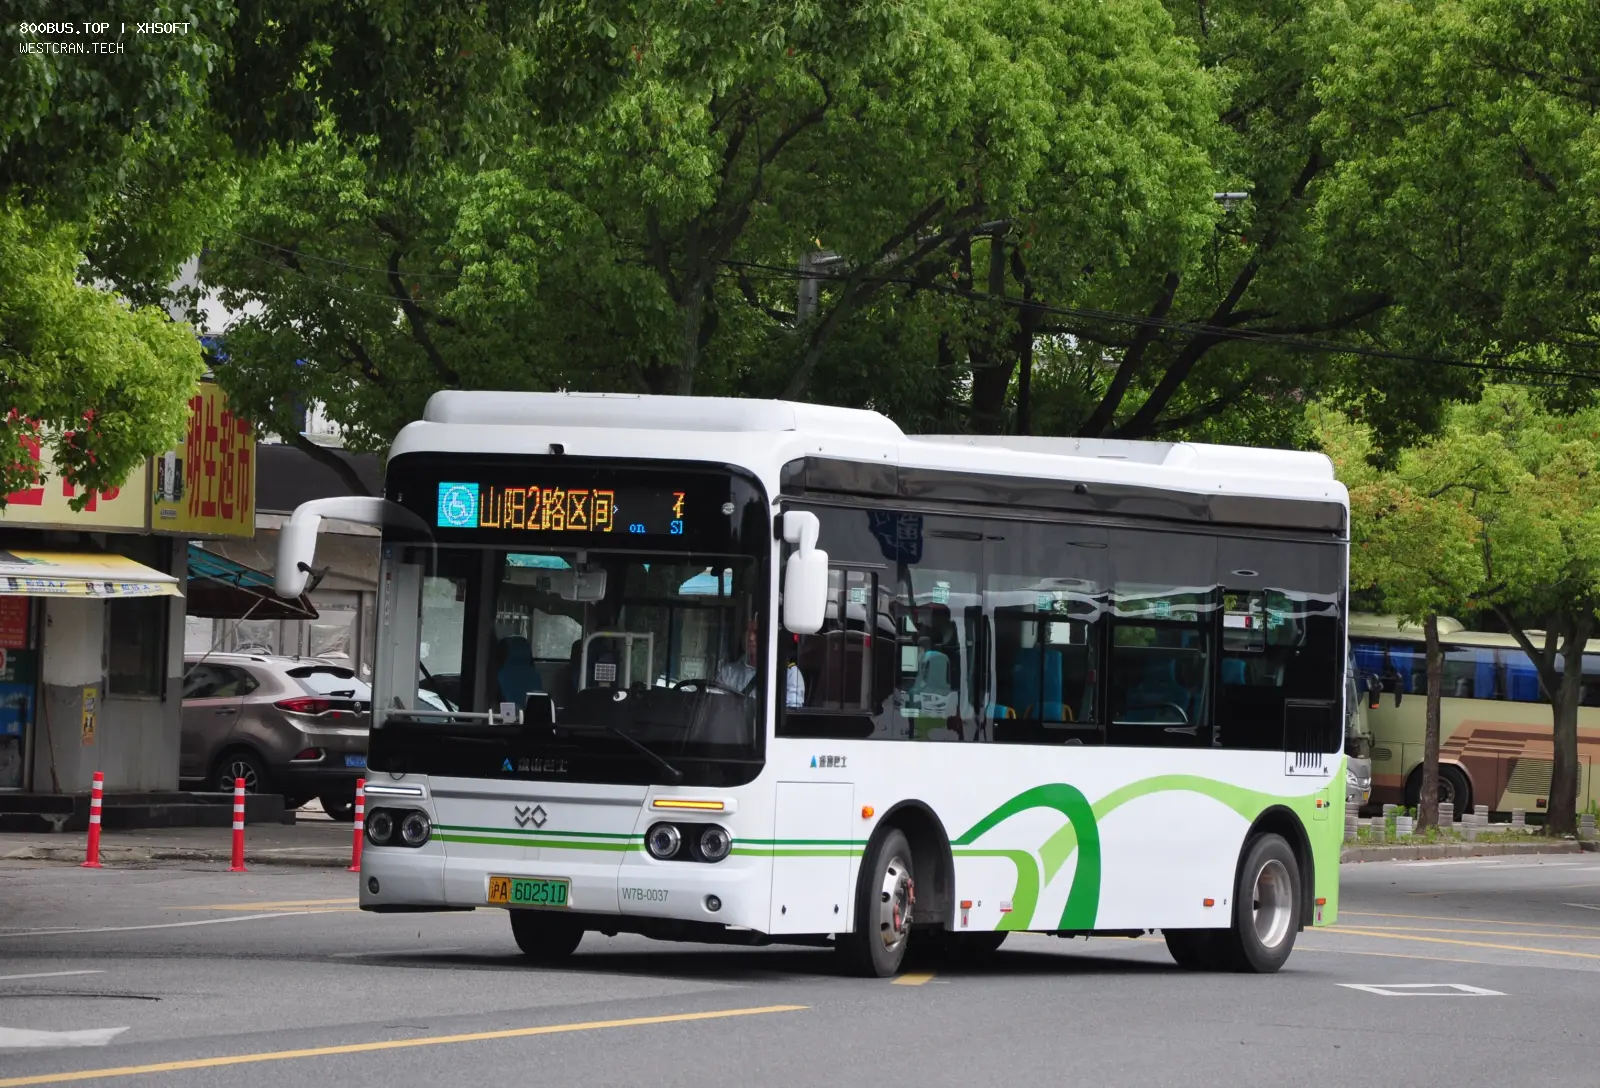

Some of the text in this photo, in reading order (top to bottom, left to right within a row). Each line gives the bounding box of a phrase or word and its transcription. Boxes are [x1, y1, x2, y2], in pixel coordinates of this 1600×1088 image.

[480, 485, 615, 532] 山阳2路区间
[621, 887, 669, 902] W7B-0037
